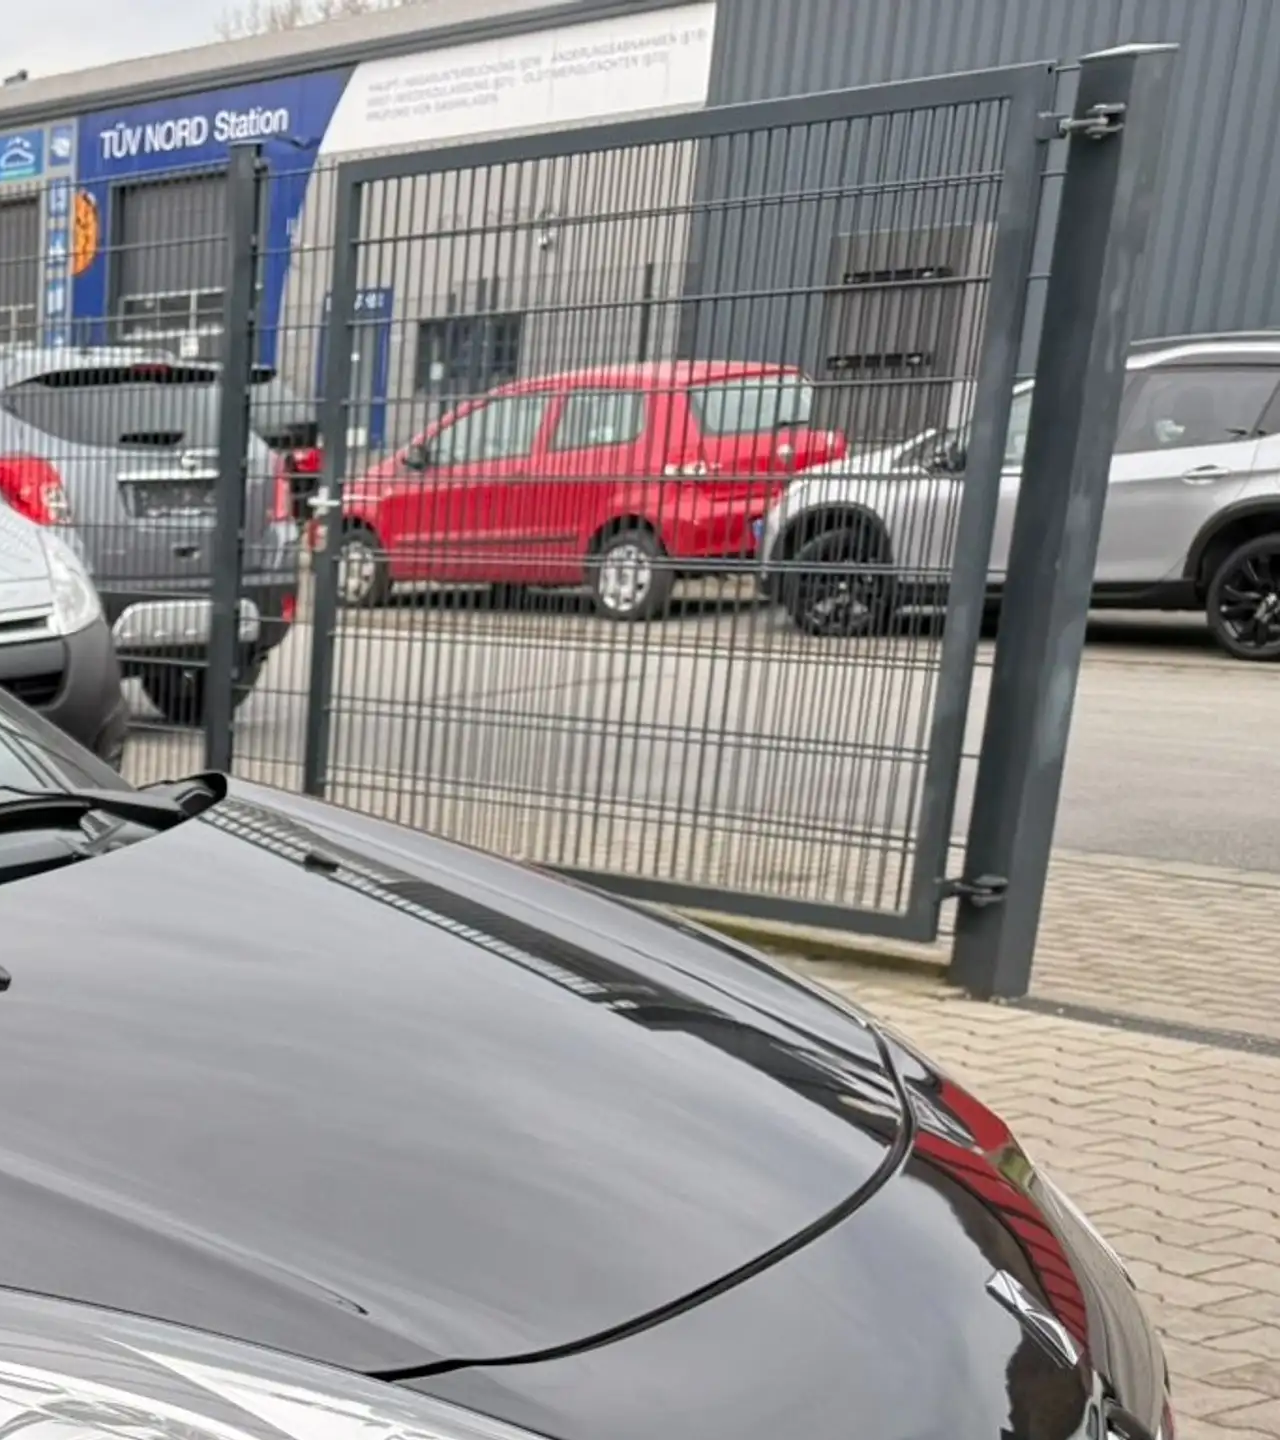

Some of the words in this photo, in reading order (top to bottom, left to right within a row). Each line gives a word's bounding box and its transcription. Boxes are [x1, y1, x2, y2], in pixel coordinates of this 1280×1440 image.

[100, 122, 142, 159] TÜV
[145, 115, 208, 153] NORD
[213, 105, 290, 141] Station
